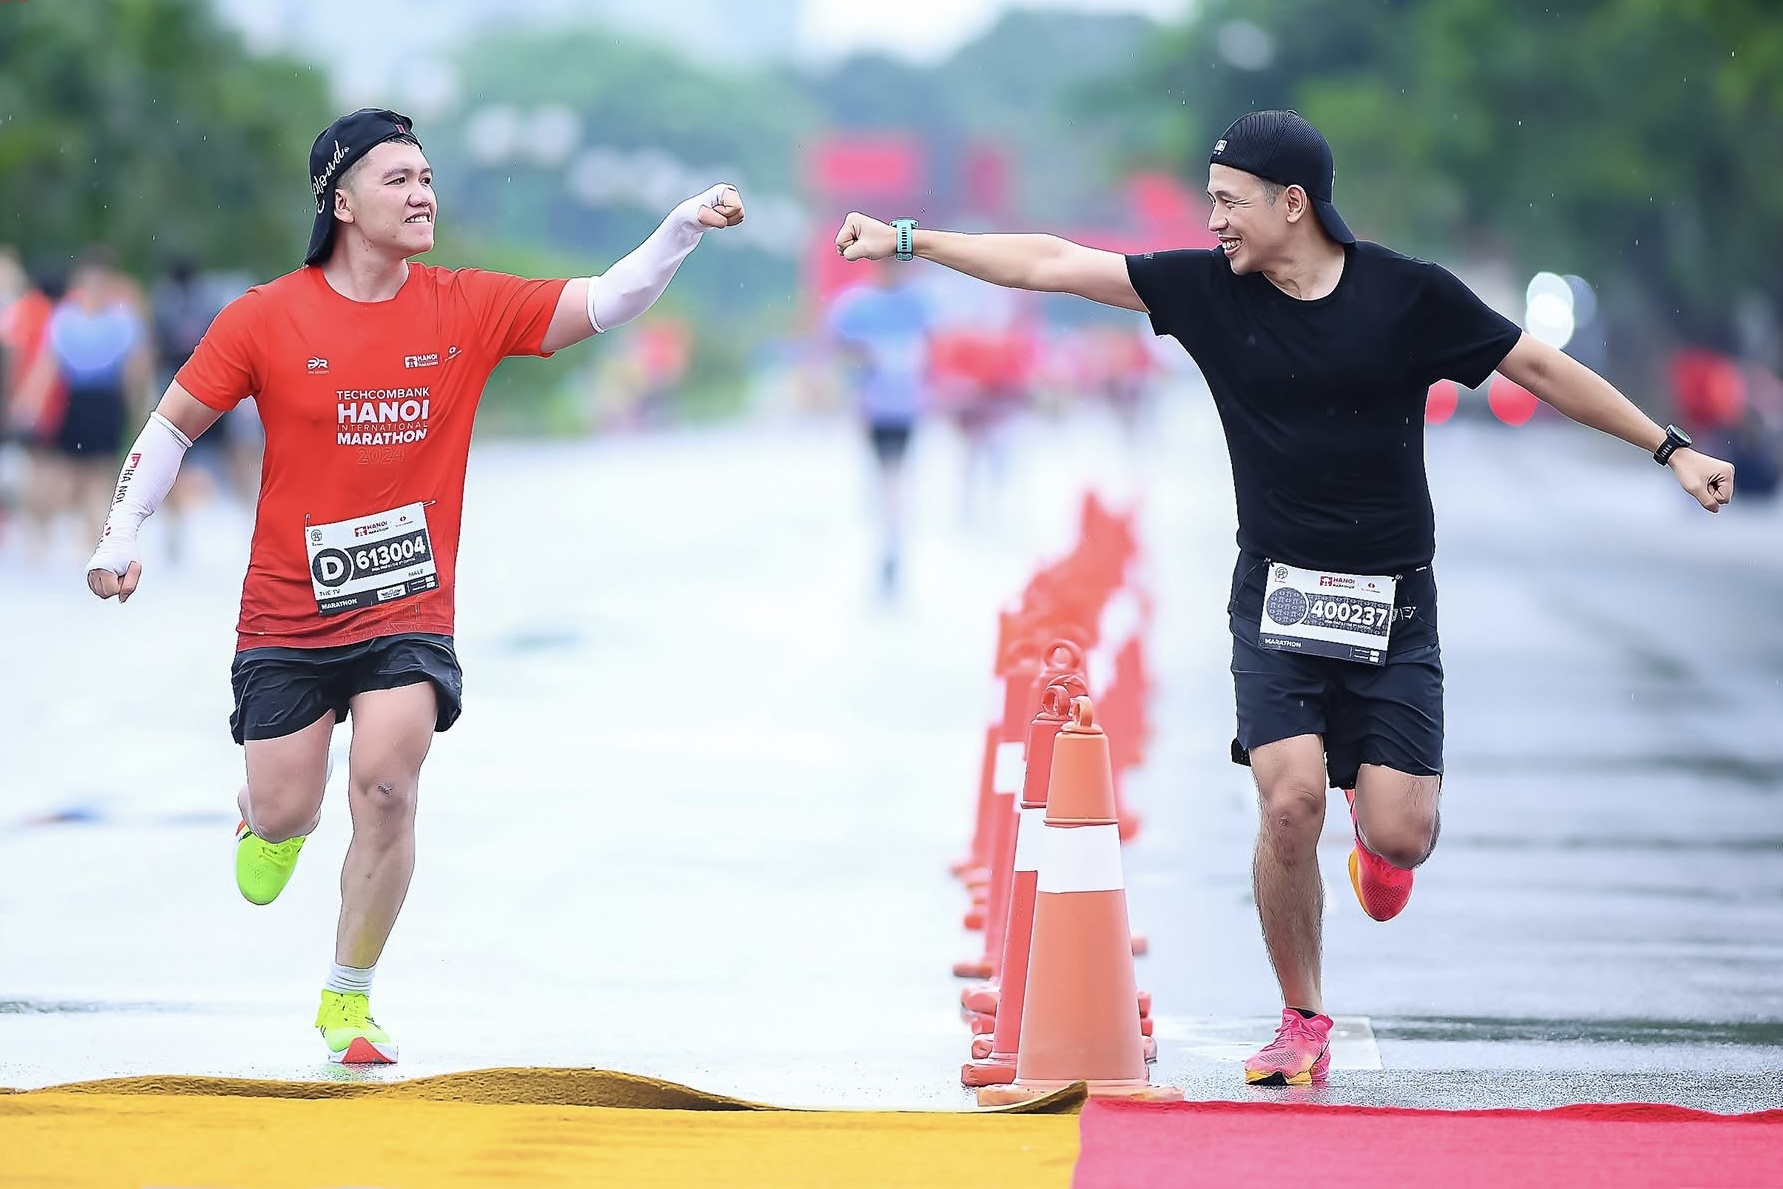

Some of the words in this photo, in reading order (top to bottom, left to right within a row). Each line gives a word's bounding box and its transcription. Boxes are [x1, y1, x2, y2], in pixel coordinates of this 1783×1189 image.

[417, 353, 438, 361] HANOI
[336, 387, 430, 400] TECHCOMBANK
[337, 400, 430, 424] HANOI
[337, 421, 428, 431] INTERNATIONAL
[337, 429, 428, 445] MARATHON
[356, 447, 405, 465] 2024
[367, 521, 388, 529] HANOI
[356, 535, 426, 570] 613004
[320, 556, 344, 581] D
[408, 569, 424, 577] MALE
[1333, 576, 1356, 585] HANOI
[321, 599, 357, 609] MARATHON
[1310, 600, 1388, 627] 400237
[1264, 638, 1302, 648] MARATHON
